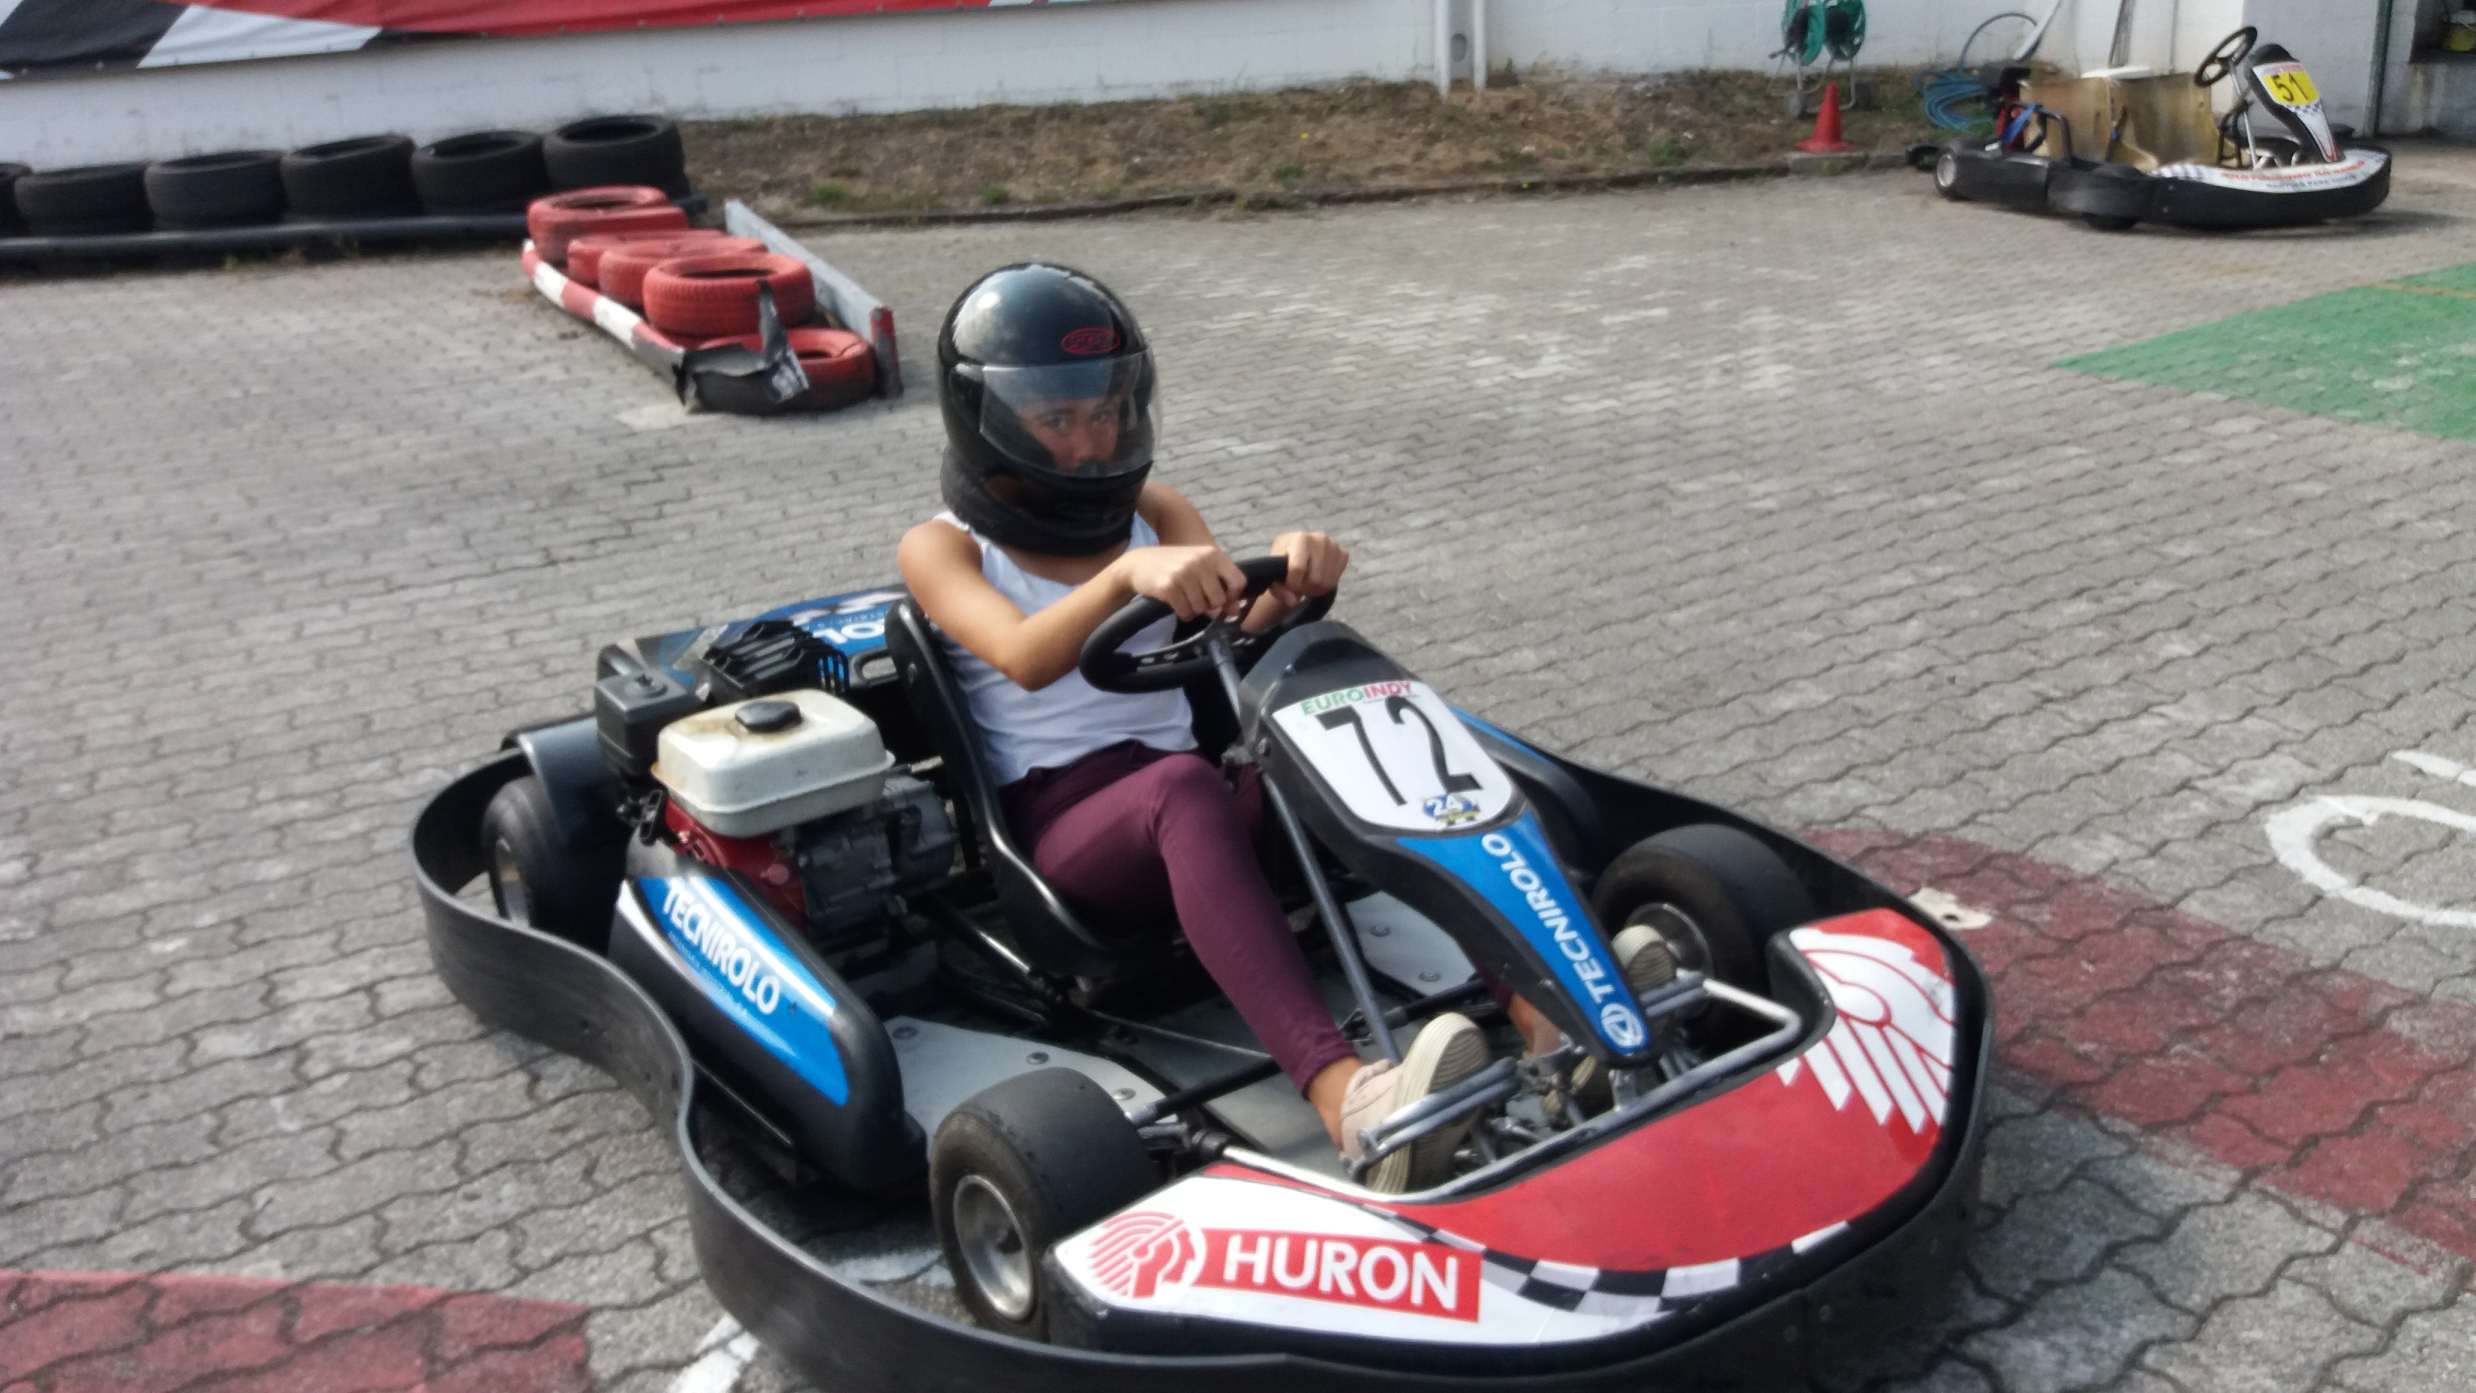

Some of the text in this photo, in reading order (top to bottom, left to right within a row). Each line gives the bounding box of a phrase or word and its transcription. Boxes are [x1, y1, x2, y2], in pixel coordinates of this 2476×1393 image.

[2270, 72, 2309, 102] 51
[1300, 681, 1412, 715] EUROINDY
[1314, 696, 1483, 806] 72
[662, 878, 781, 1015] TECNIROLO
[1481, 833, 1615, 1004] TECNIROLO
[1223, 1234, 1457, 1311] HURON
